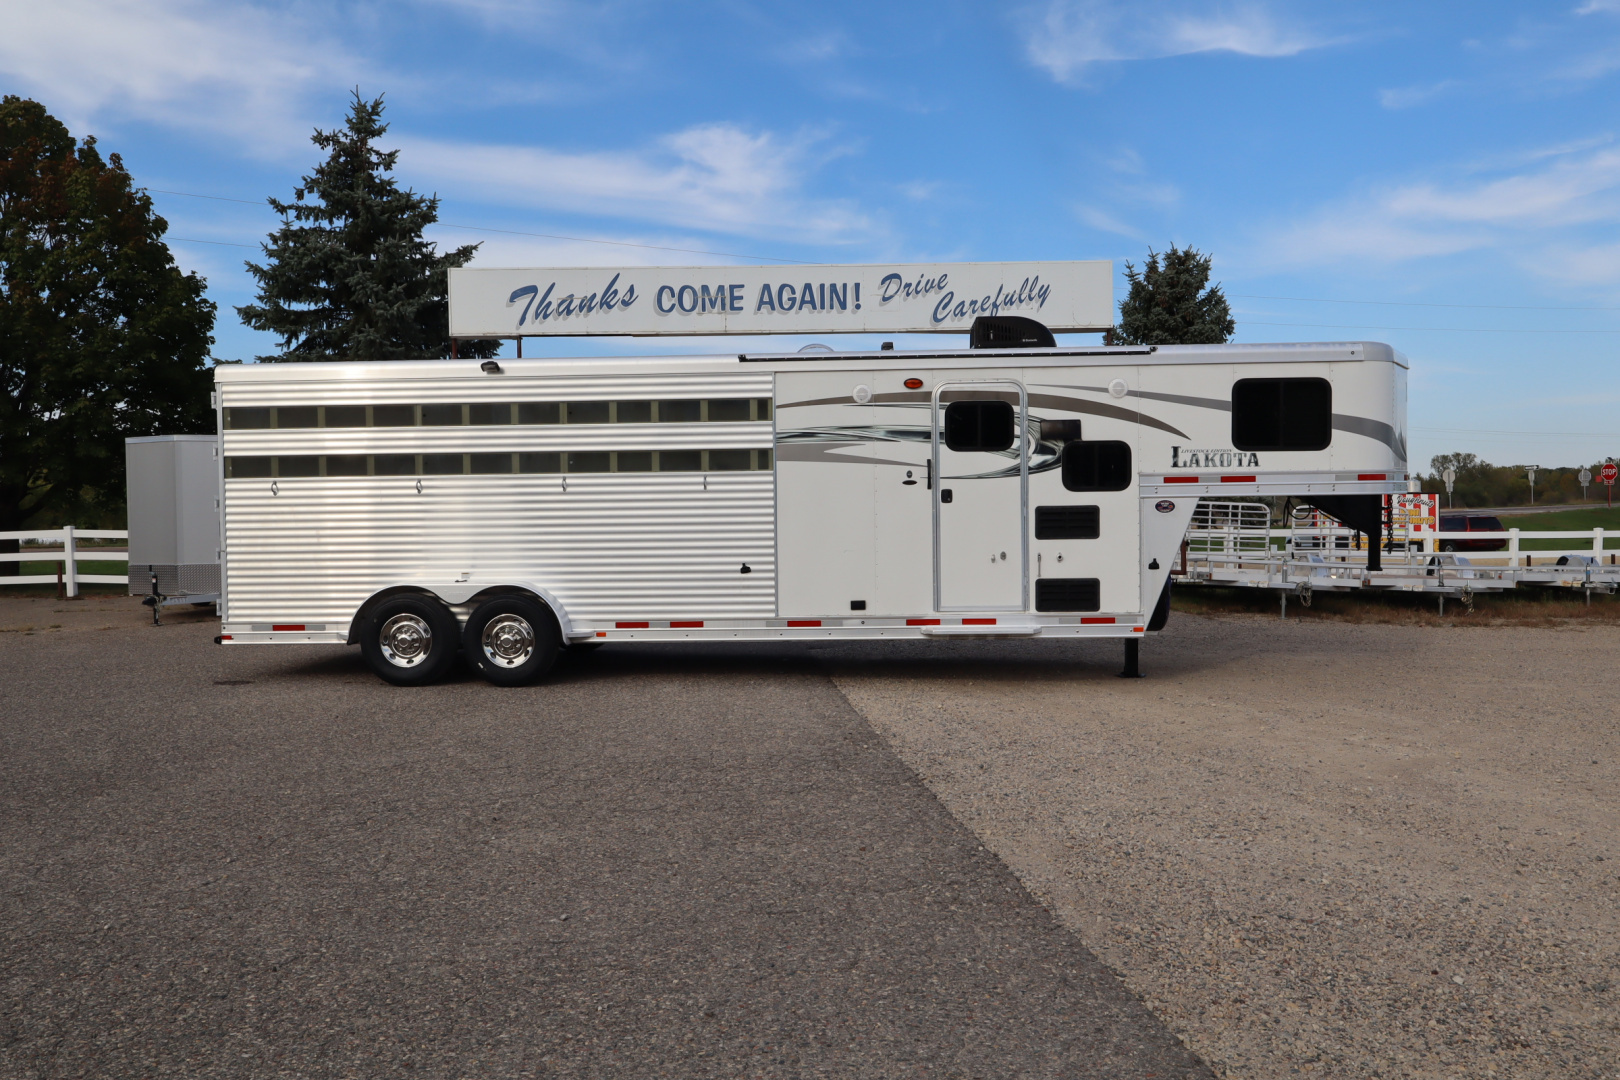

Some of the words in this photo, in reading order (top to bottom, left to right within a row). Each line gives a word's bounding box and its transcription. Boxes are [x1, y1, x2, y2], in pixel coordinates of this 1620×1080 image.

[508, 272, 639, 327] Thanks
[656, 284, 746, 314] COME
[756, 282, 862, 311] AGAIN!
[880, 272, 949, 303] Drive
[932, 275, 1052, 324] Carefully
